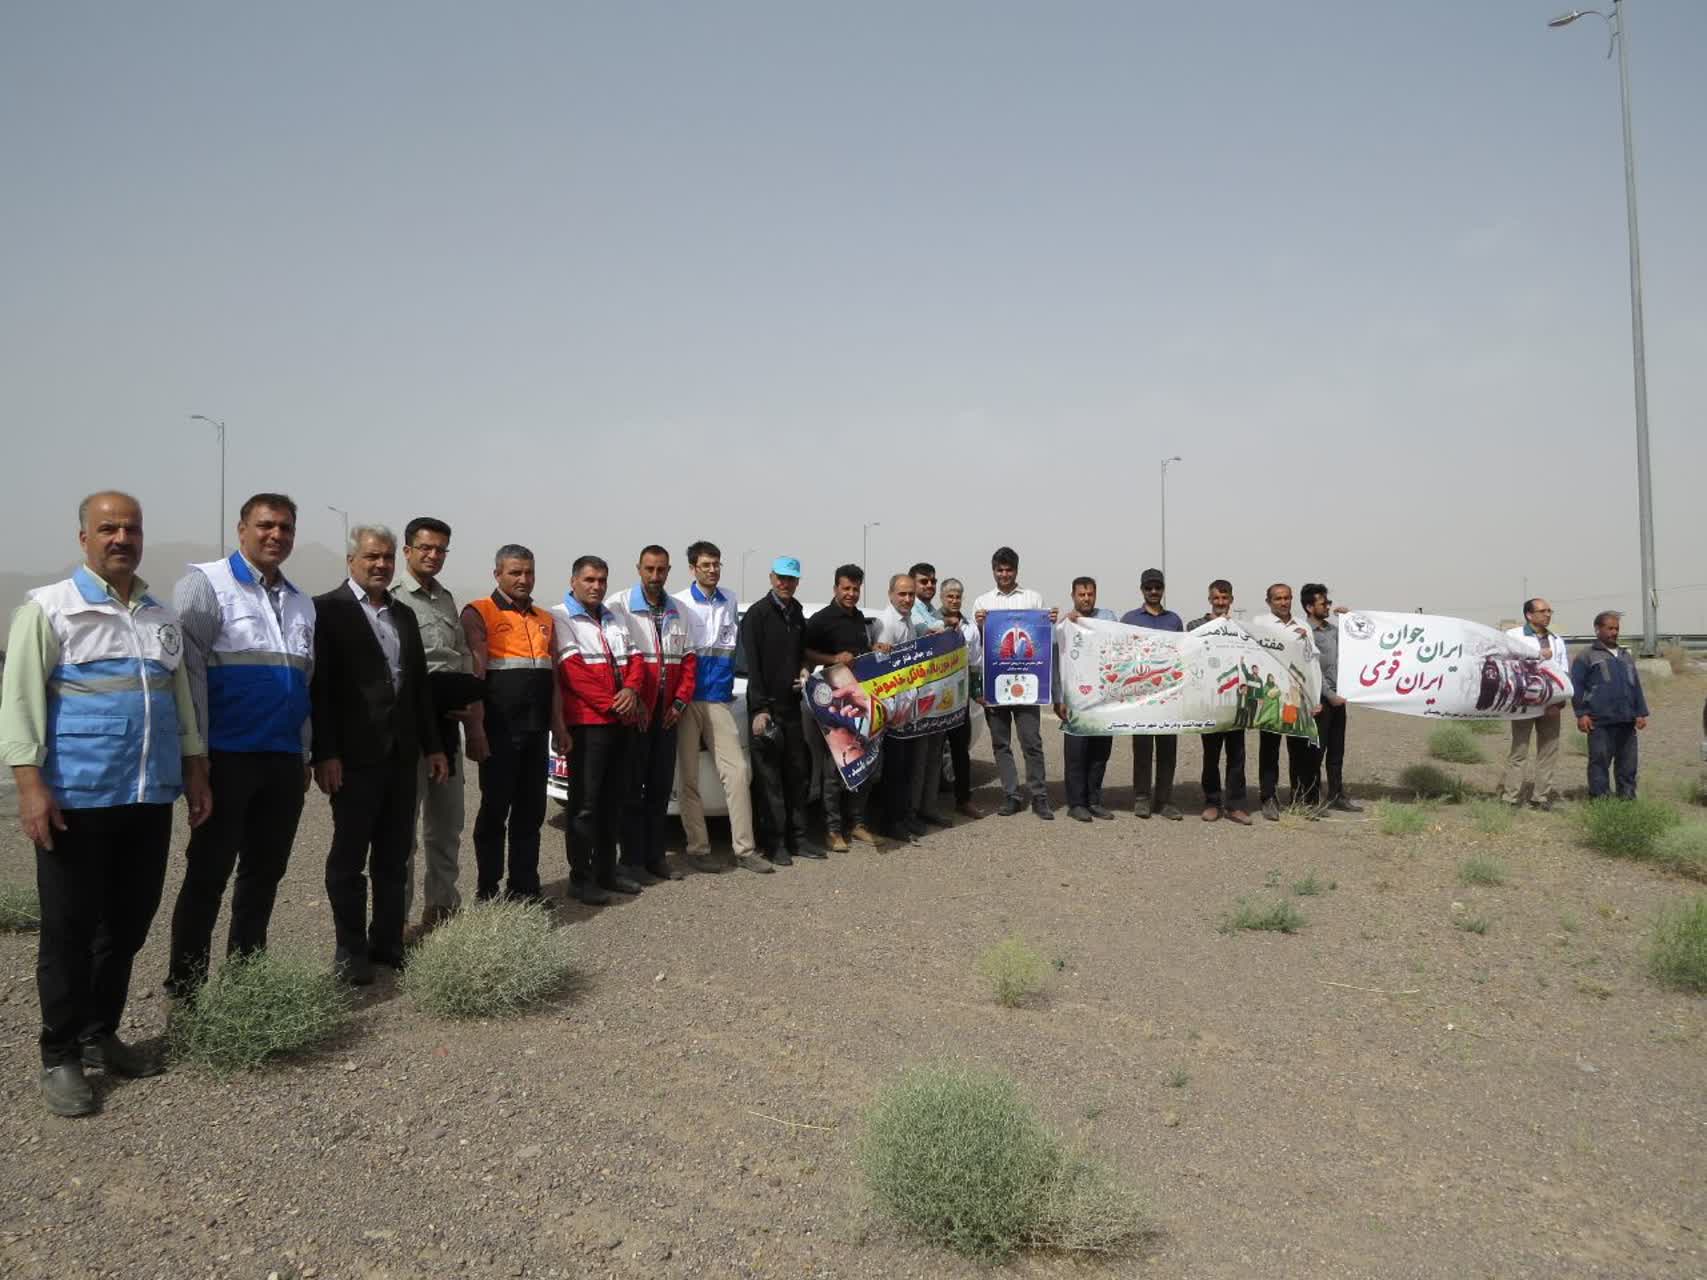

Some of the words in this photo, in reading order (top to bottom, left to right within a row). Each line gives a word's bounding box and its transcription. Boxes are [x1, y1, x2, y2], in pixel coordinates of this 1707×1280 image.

[1379, 623, 1425, 650] جوان
[1359, 650, 1402, 687] قوی
[1416, 641, 1463, 672] ایران
[872, 674, 906, 696] خاموش
[1395, 672, 1443, 705] ایران
